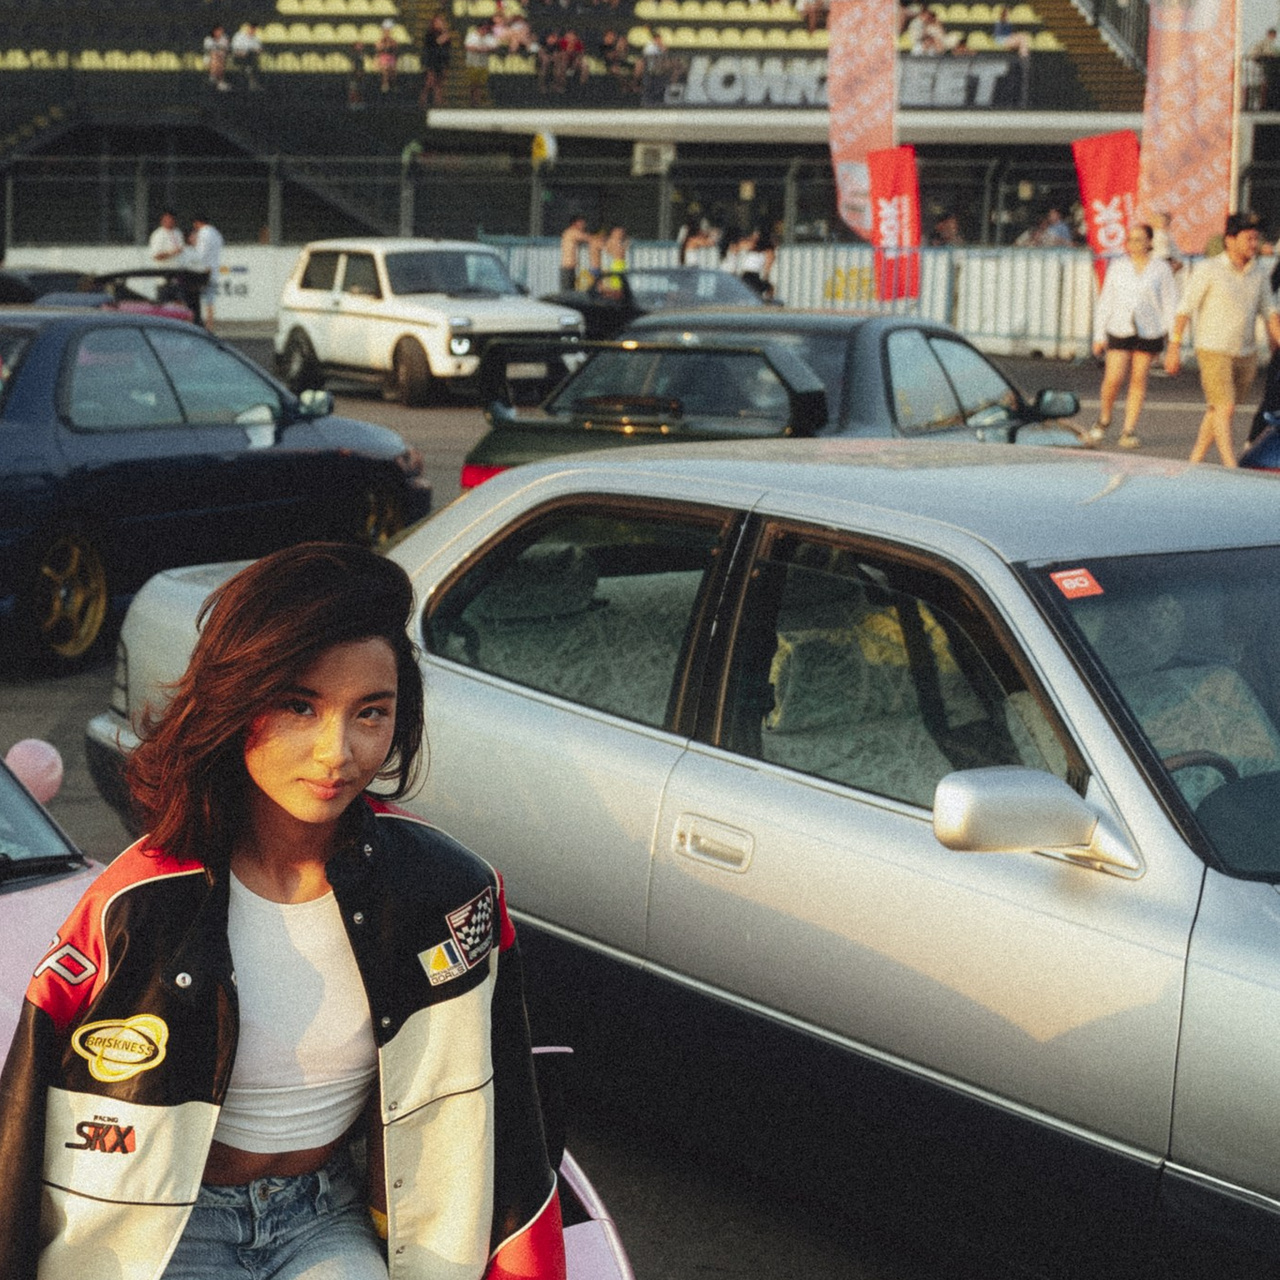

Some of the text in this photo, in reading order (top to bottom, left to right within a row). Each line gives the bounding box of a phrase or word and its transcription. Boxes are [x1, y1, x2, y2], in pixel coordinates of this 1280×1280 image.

[685, 56, 1008, 105] LOWKEET
[86, 1035, 155, 1057] BRISKNESS
[93, 1114, 119, 1123] RACING
